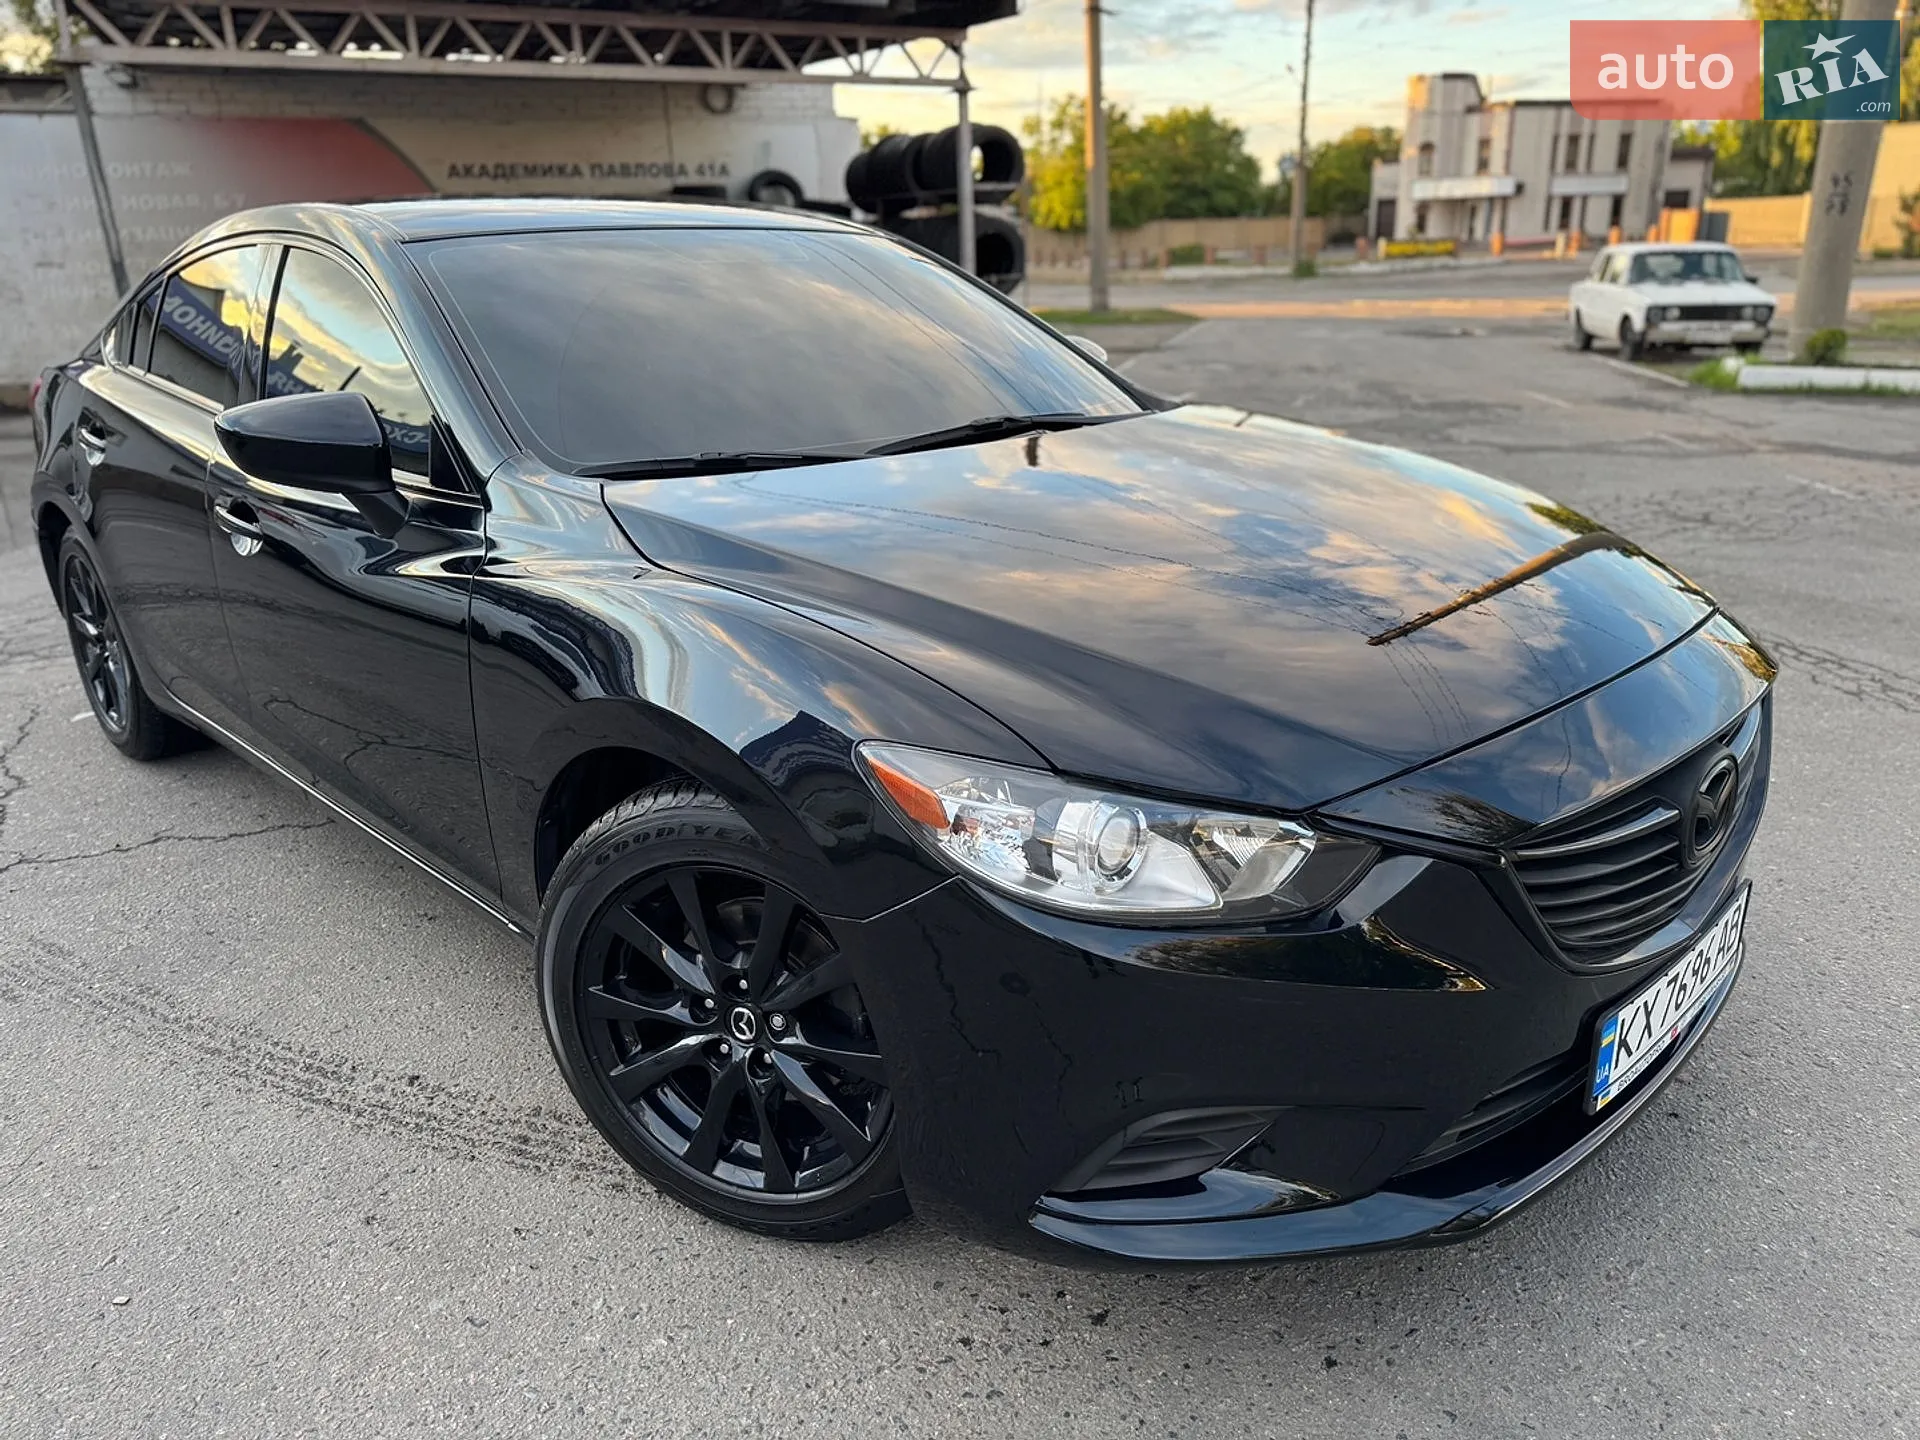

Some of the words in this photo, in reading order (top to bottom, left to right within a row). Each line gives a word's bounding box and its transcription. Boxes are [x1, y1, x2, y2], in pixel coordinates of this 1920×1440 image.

[447, 162, 583, 183] АКАДЕМИКА
[588, 162, 688, 178] ПАВЛОВА
[594, 822, 764, 868] GOODYEA
[1614, 989, 1660, 1071] KX
[1659, 933, 1716, 1029] 7696
[1596, 1062, 1609, 1084] UA
